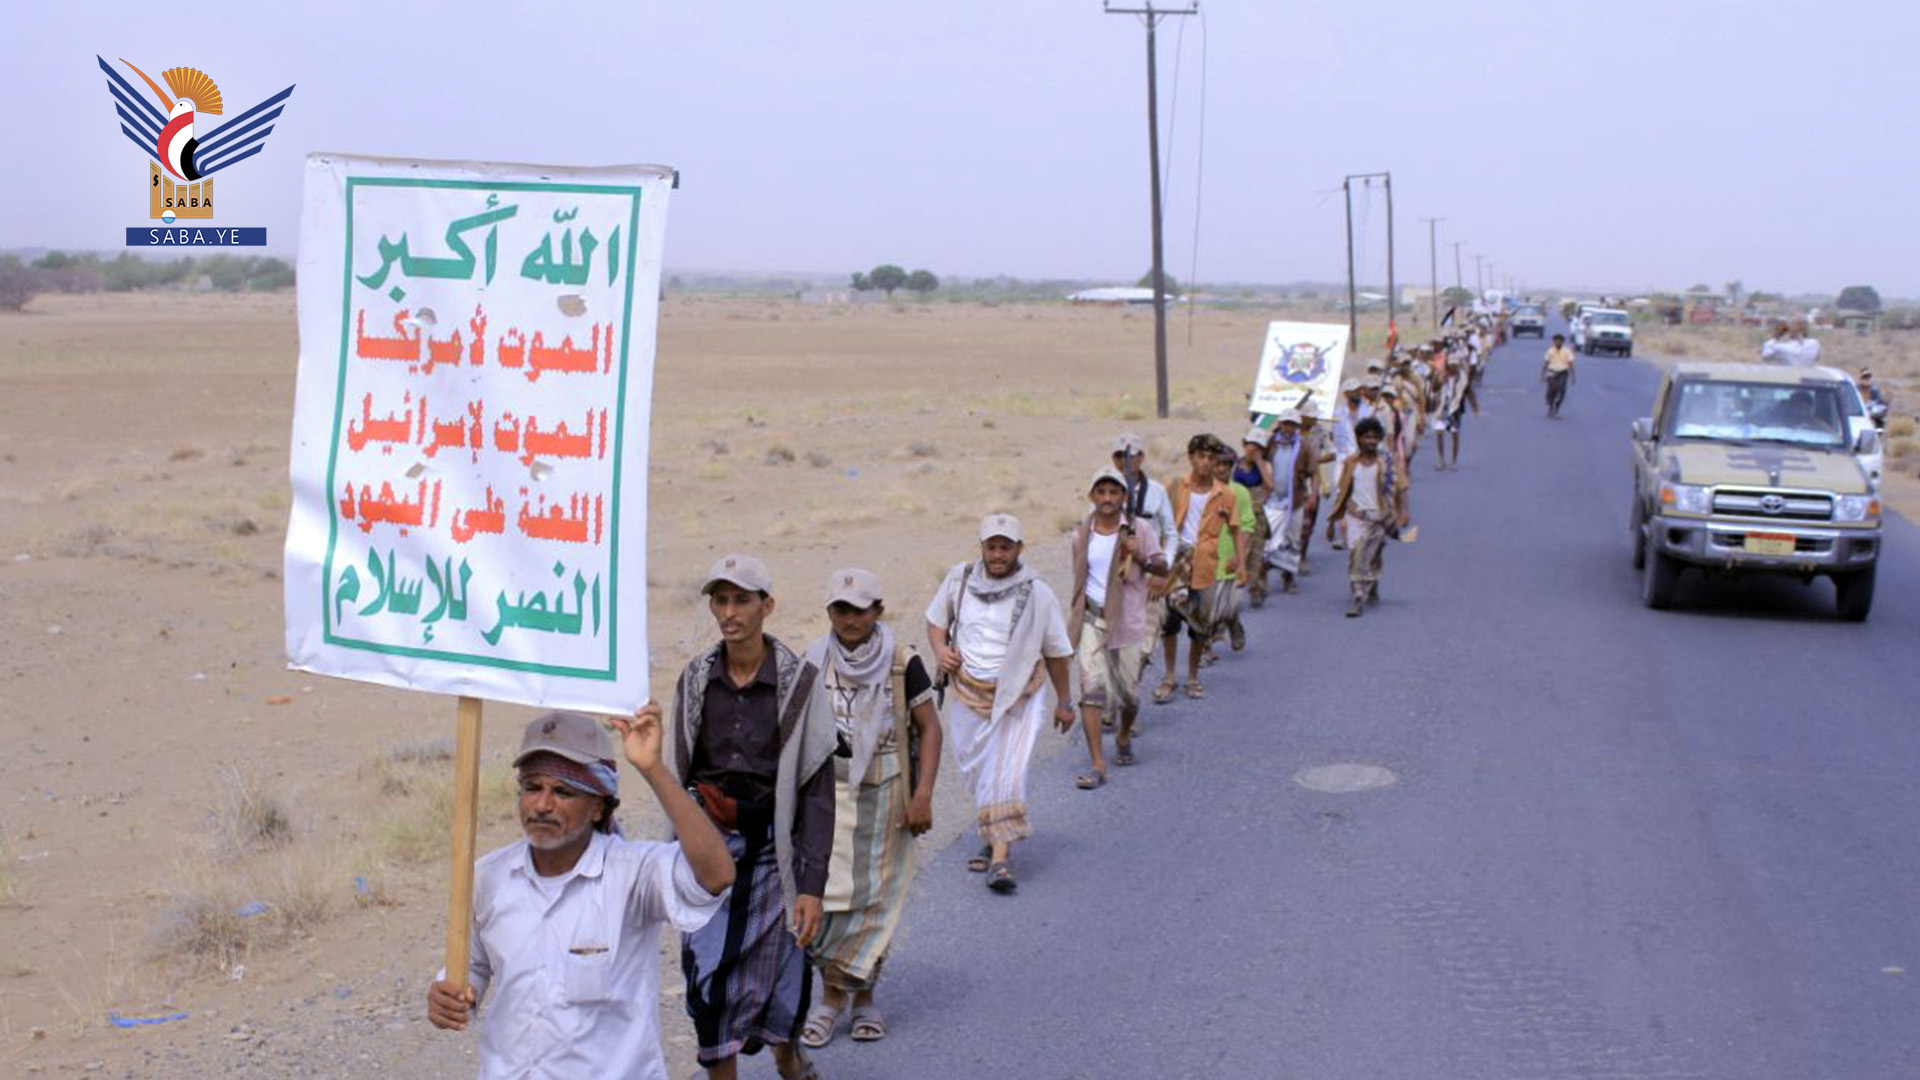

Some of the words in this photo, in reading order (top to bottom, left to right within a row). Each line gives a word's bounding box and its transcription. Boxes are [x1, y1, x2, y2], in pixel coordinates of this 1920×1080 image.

[356, 193, 519, 302] أكبر
[518, 205, 621, 287] الله
[498, 323, 614, 382] الموت
[347, 391, 484, 465] لإسرائيل
[494, 409, 608, 466] الموت
[339, 479, 443, 537] اليهود
[451, 482, 507, 544] على
[517, 487, 604, 545] اللعنة
[333, 545, 474, 645] للإسلام
[481, 560, 602, 647] النصر
